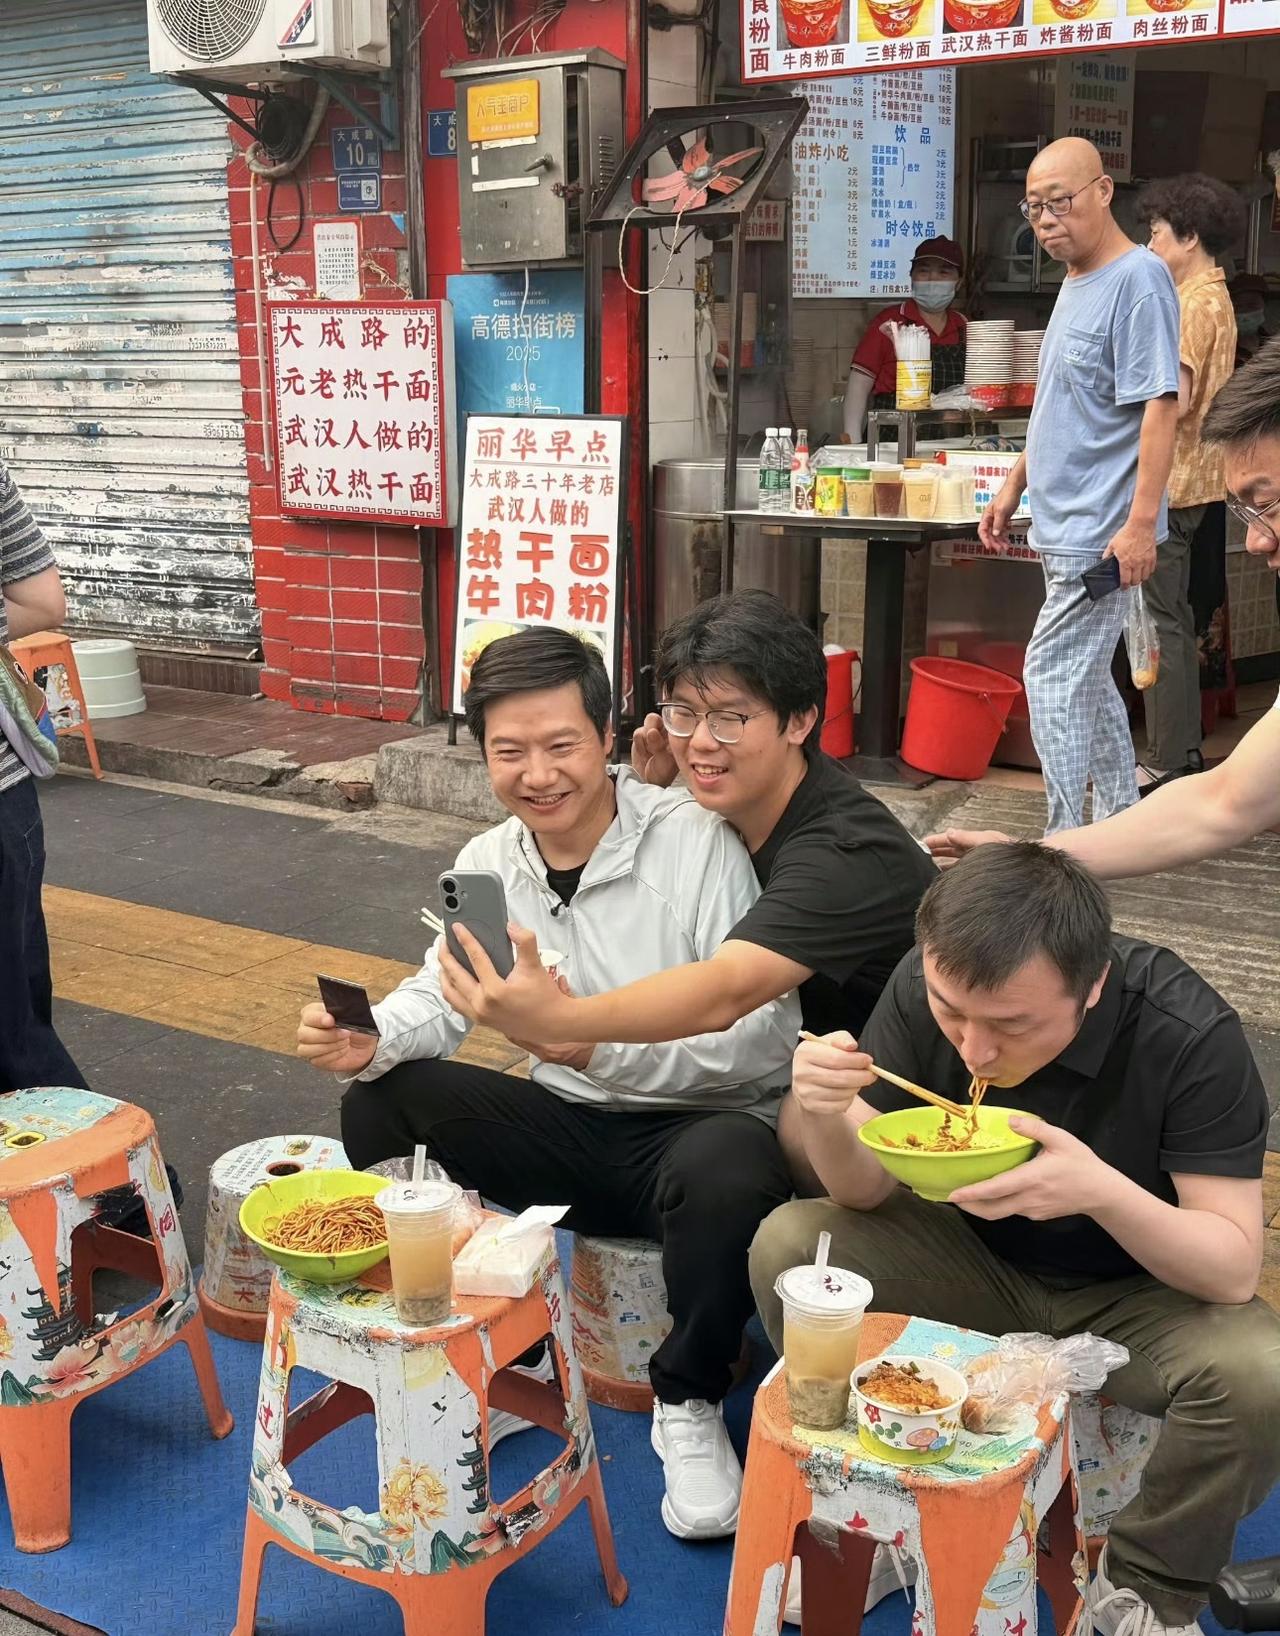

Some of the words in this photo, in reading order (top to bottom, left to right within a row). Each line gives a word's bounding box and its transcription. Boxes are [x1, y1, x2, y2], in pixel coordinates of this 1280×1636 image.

[1040, 21, 1113, 46] 炸酱粉面
[1133, 13, 1210, 39] 肉丝粉面
[865, 40, 932, 62] 三鲜粉面
[941, 29, 1029, 54] 武汉热干面
[783, 47, 846, 70] 牛肉粉面
[894, 124, 931, 144] 饮品
[346, 142, 364, 166] 10
[795, 141, 850, 162] 油炸小吃
[886, 220, 936, 237] 时令饮品
[278, 315, 431, 351] 大成路的
[470, 312, 577, 341] 高德扫街榜
[506, 345, 541, 361] 2025
[281, 366, 431, 402] 元老热干面
[284, 413, 434, 453] 武汉人做的
[476, 426, 611, 465] 丽华早点
[287, 463, 434, 504] 武汉热干面
[468, 466, 615, 497] 大成路三十年老店
[486, 496, 590, 529] 武汉人做的
[466, 527, 610, 576] 热干面
[466, 574, 610, 624] 牛肉粉
